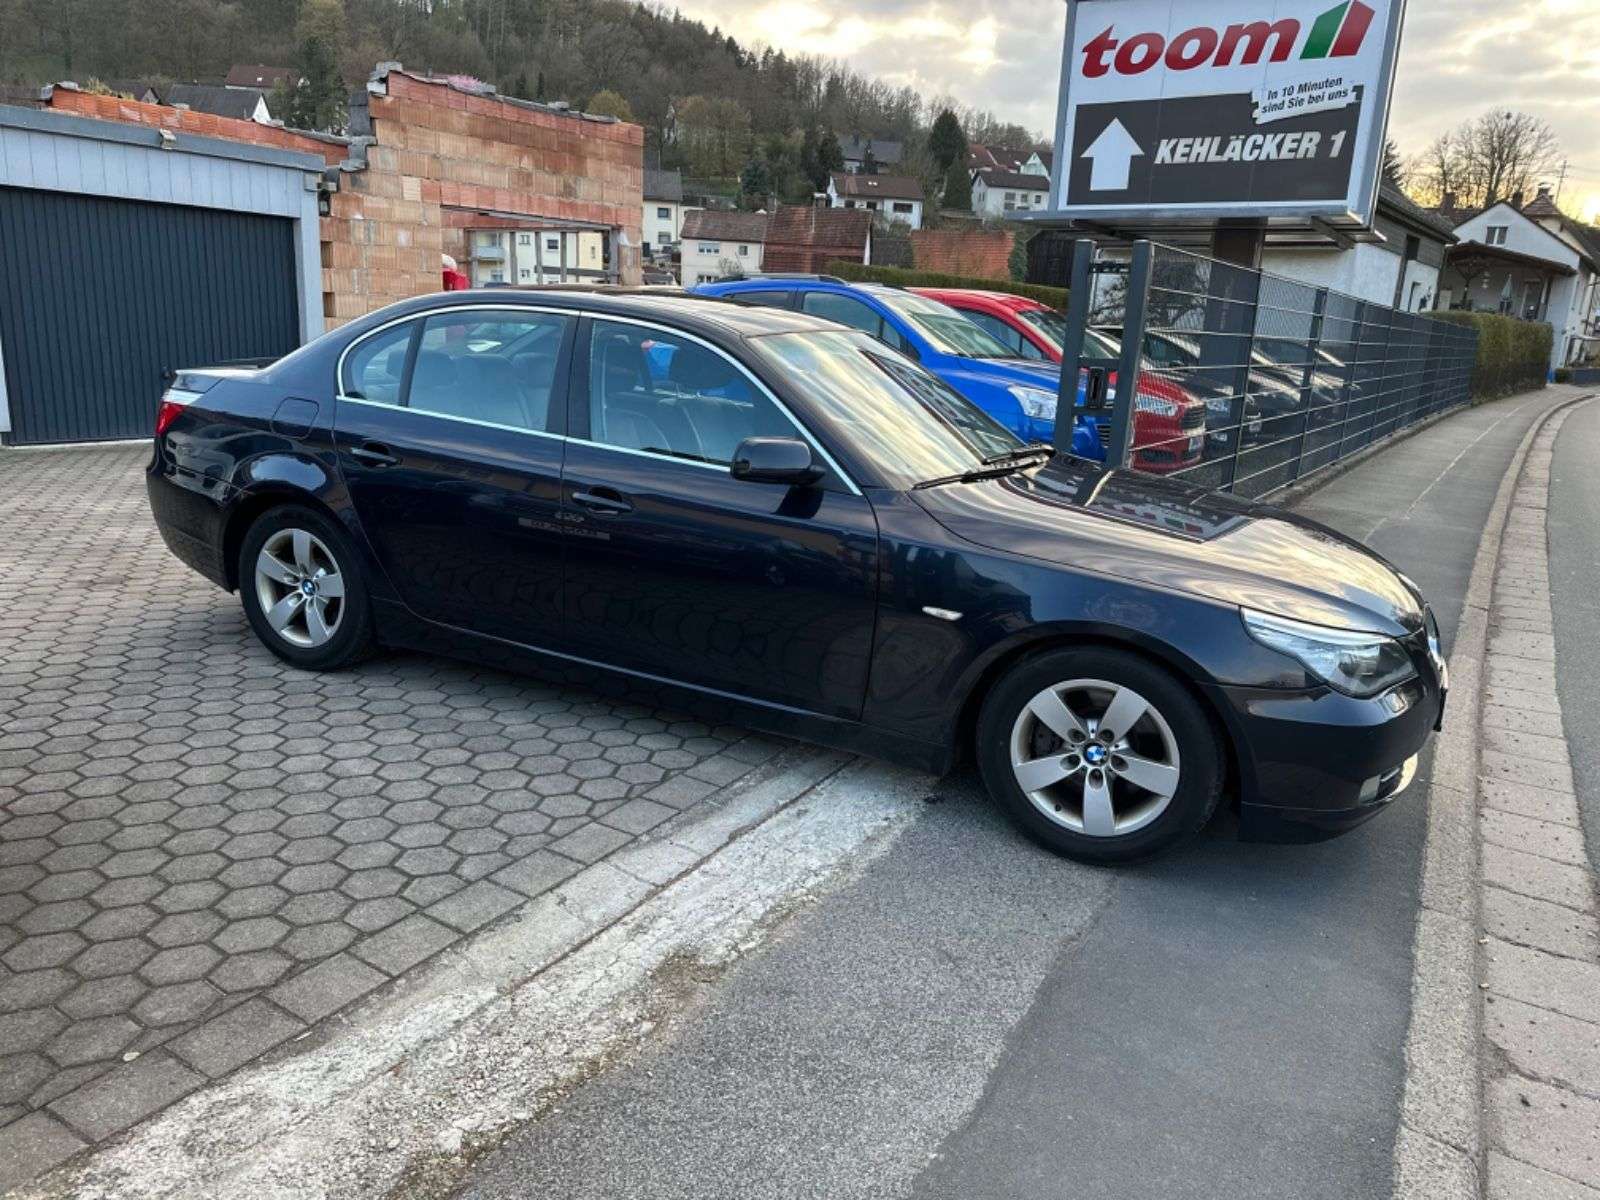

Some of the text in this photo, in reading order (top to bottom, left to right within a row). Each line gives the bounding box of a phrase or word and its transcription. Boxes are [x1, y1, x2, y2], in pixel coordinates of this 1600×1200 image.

[1082, 18, 1300, 78] toom
[1261, 89, 1348, 113] sind Sie bei uns
[1267, 77, 1343, 100] In 10 Minuten
[1154, 130, 1346, 164] KEHLÄCKER 1
